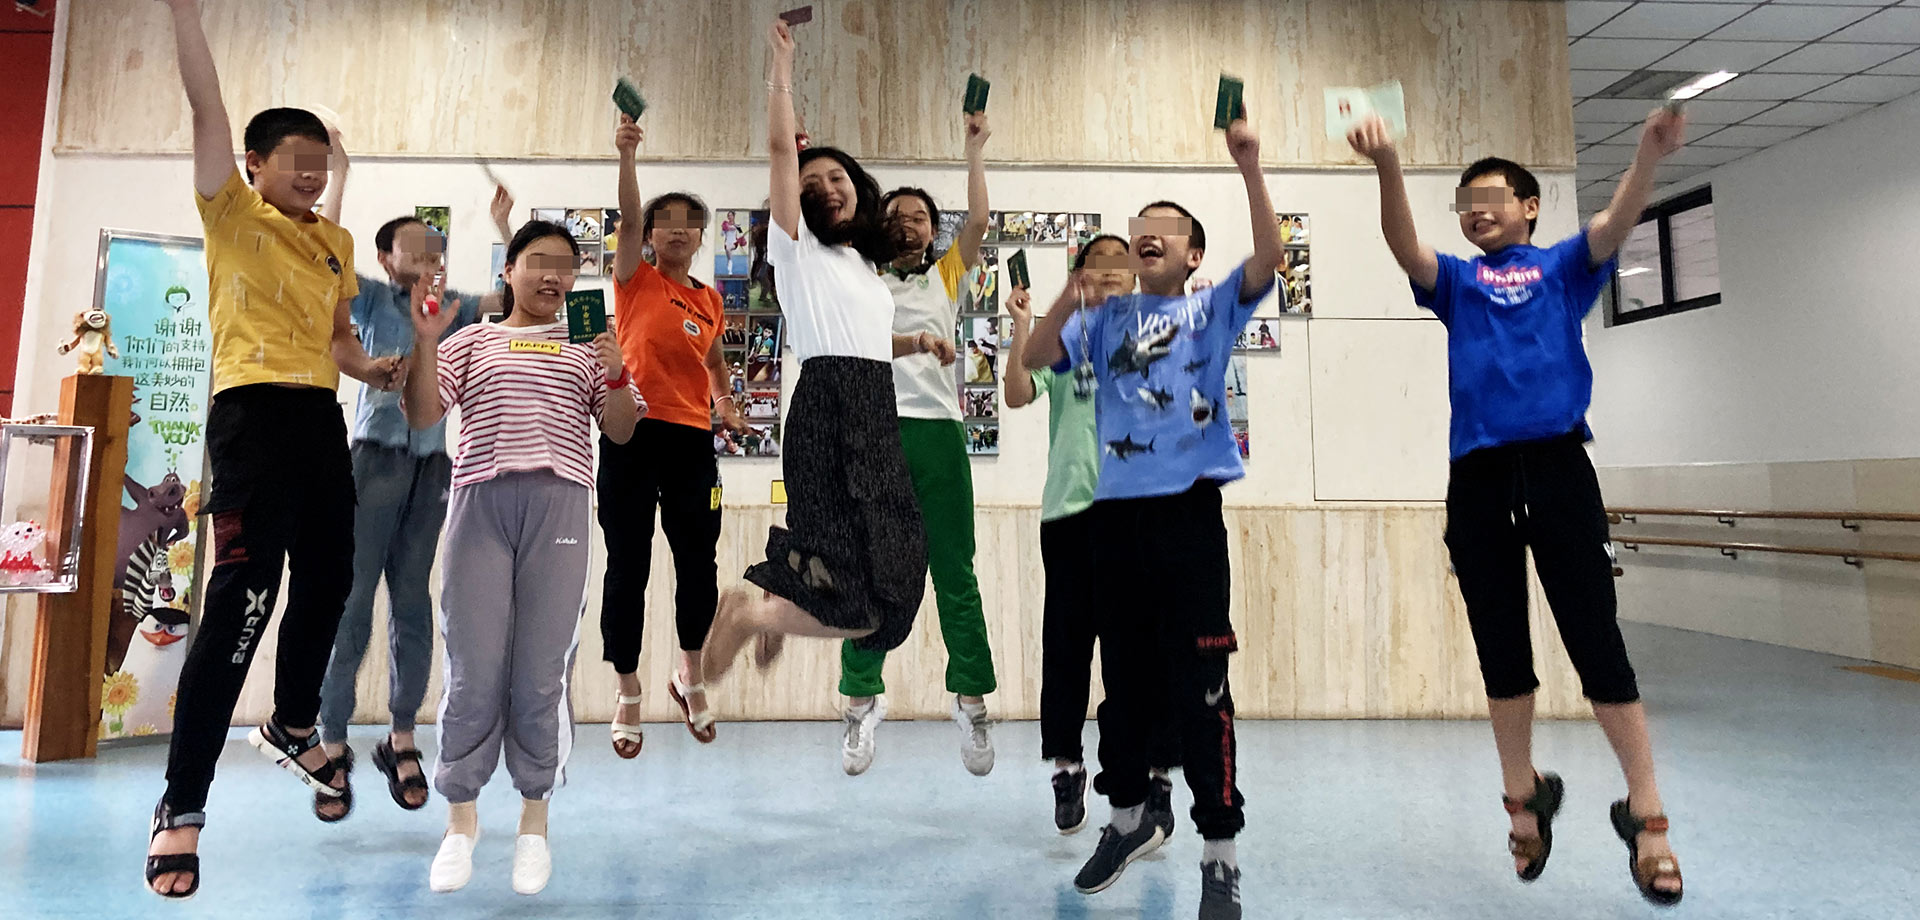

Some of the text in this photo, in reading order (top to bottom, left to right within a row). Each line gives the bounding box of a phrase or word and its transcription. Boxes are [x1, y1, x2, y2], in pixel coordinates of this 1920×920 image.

[154, 317, 202, 337] 谢谢
[515, 342, 556, 350] HAPPY
[122, 355, 206, 372] 我们可以拥抱
[134, 372, 195, 388] 这美妙的
[149, 420, 203, 436] THANK
[161, 432, 190, 445] YOU
